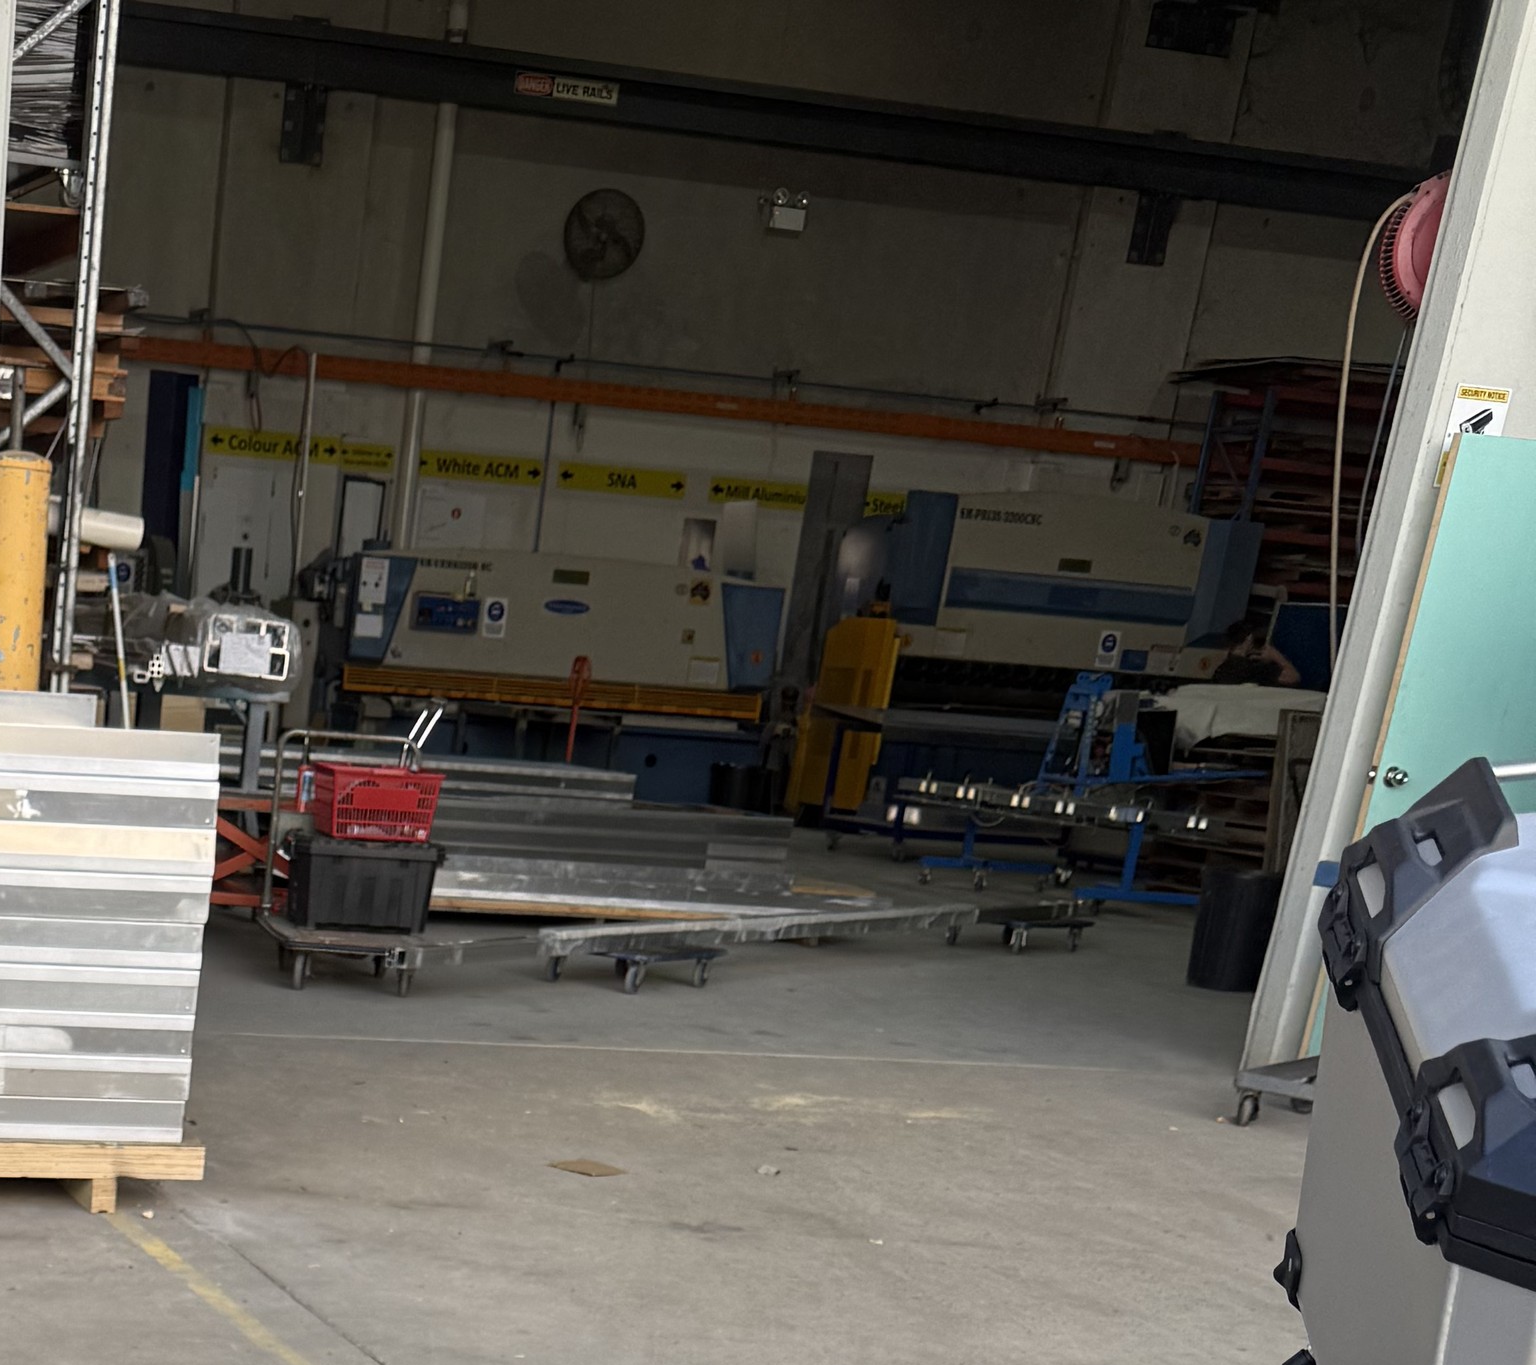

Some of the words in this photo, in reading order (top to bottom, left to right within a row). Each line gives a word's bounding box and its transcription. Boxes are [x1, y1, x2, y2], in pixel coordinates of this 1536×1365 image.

[556, 82, 578, 96] LIVE
[582, 86, 614, 100] RAILS
[1460, 388, 1487, 398] SECURITY
[1487, 391, 1508, 401] NOTICE
[228, 434, 280, 454] Colour
[436, 457, 481, 476] White
[484, 462, 520, 479] ACM
[607, 471, 638, 490] SNA
[725, 484, 751, 500] Mill
[752, 487, 807, 506] Aluminiu
